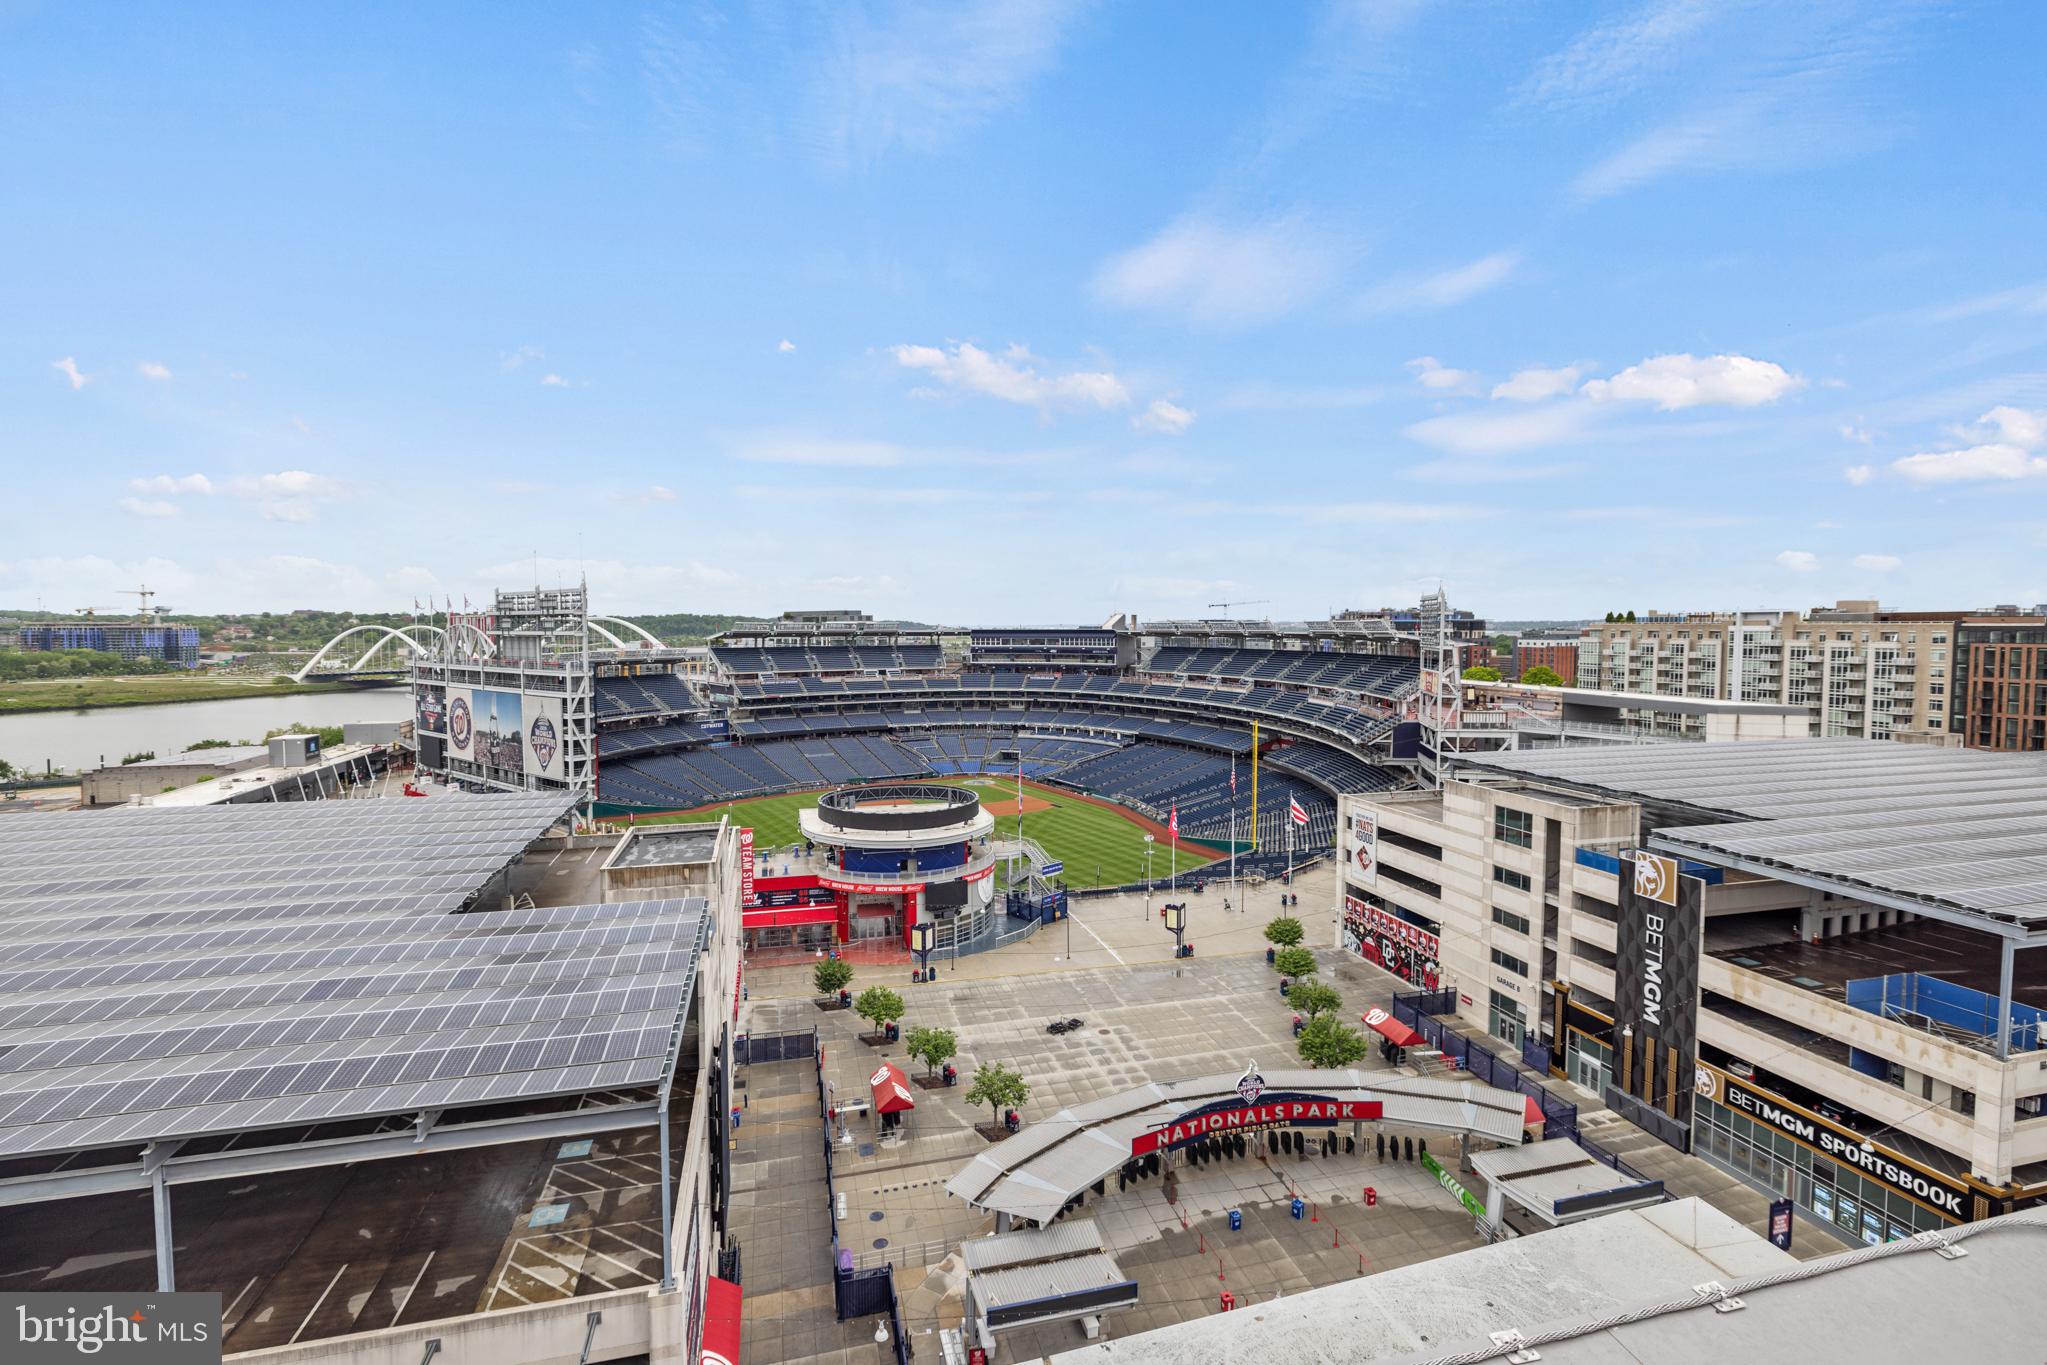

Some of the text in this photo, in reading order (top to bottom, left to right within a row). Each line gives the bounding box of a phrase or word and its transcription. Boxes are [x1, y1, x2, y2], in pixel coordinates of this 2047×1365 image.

[1355, 818, 1374, 834] #NATS
[1355, 829, 1374, 845] 4GOOD
[742, 846, 753, 870] TEAM
[743, 872, 754, 900] STORE
[1382, 938, 1395, 967] DC
[1642, 913, 1664, 1026] BETMGM
[1496, 975, 1516, 991] GARAGE
[1157, 1103, 1355, 1147] NATIONALS PARK
[1209, 1120, 1291, 1138] CENTER FIELD GATE
[1729, 1087, 1962, 1216] BETMGM SPORTSBOOK
